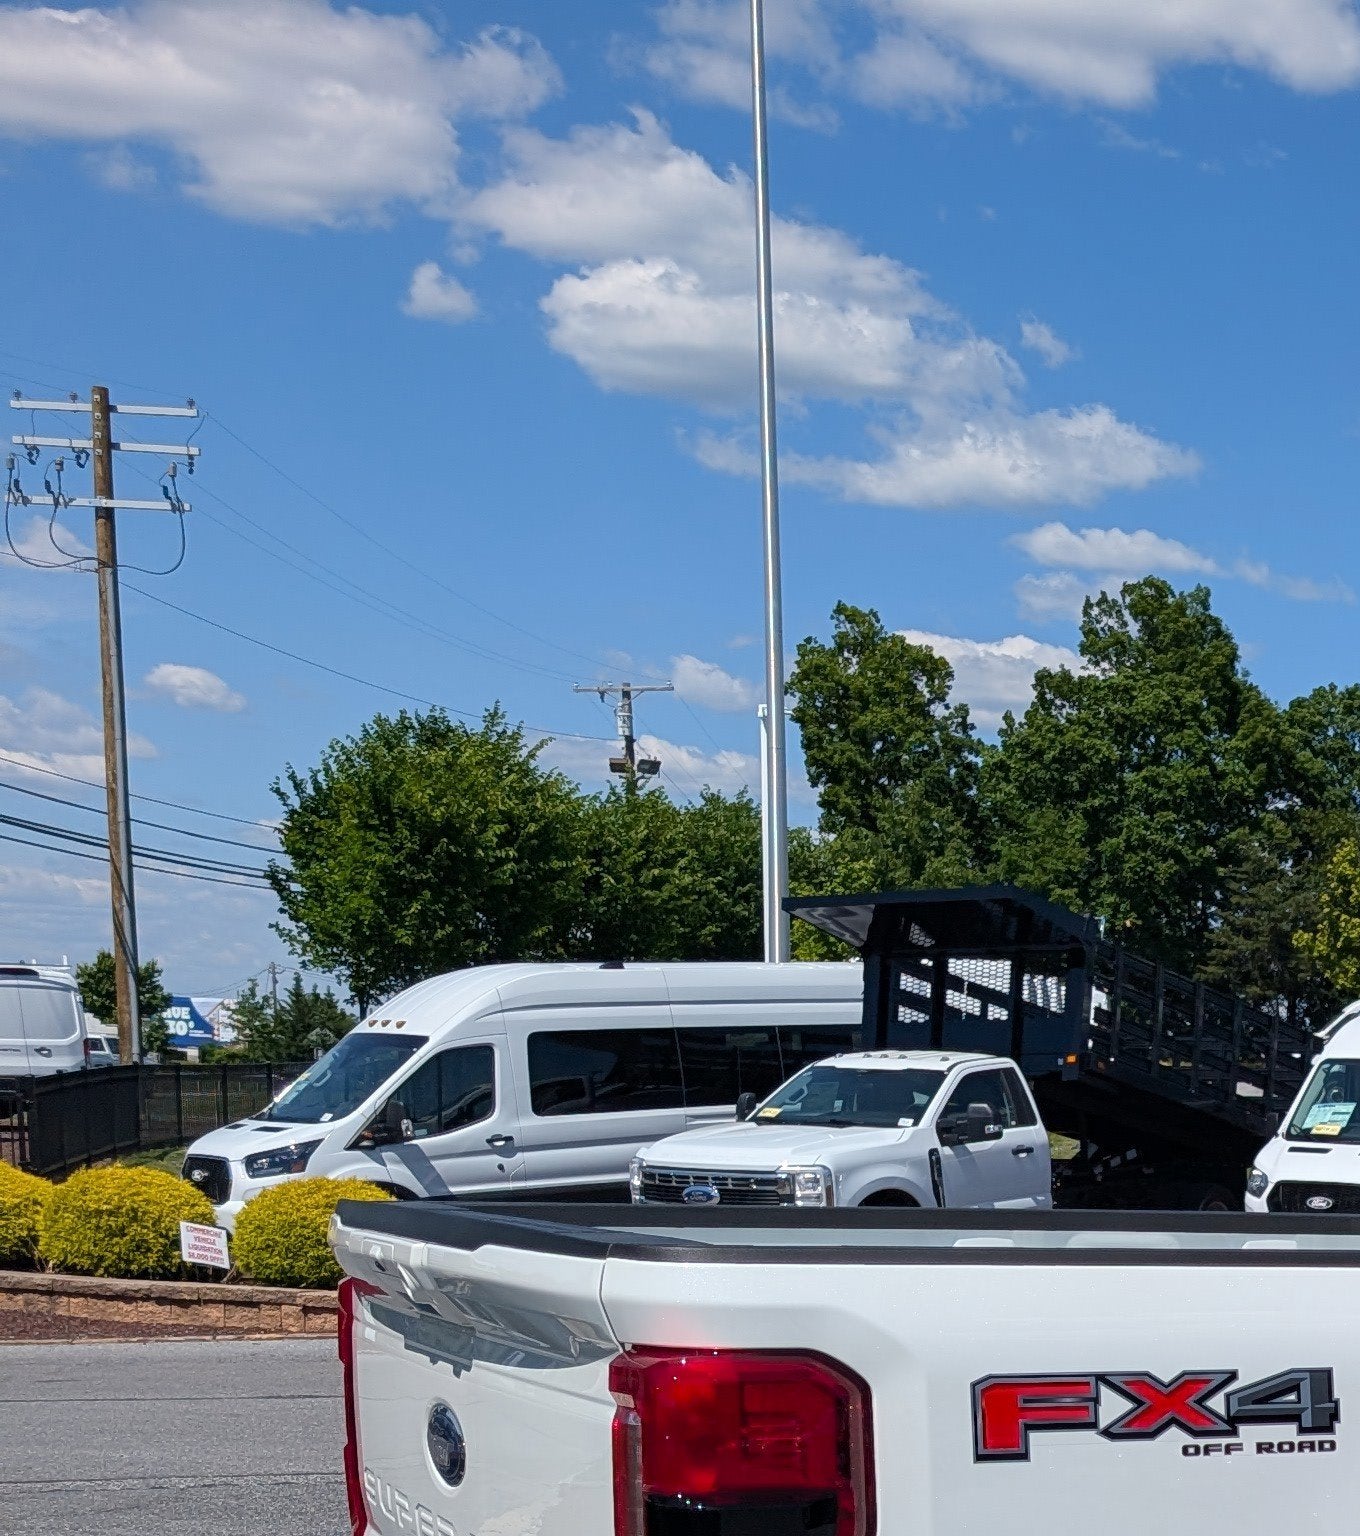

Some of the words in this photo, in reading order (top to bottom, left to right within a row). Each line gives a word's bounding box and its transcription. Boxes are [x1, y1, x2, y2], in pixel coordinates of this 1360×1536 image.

[970, 1367, 1340, 1463] FX4
[1181, 1443, 1244, 1457] OFF
[1255, 1439, 1337, 1454] ROAD
